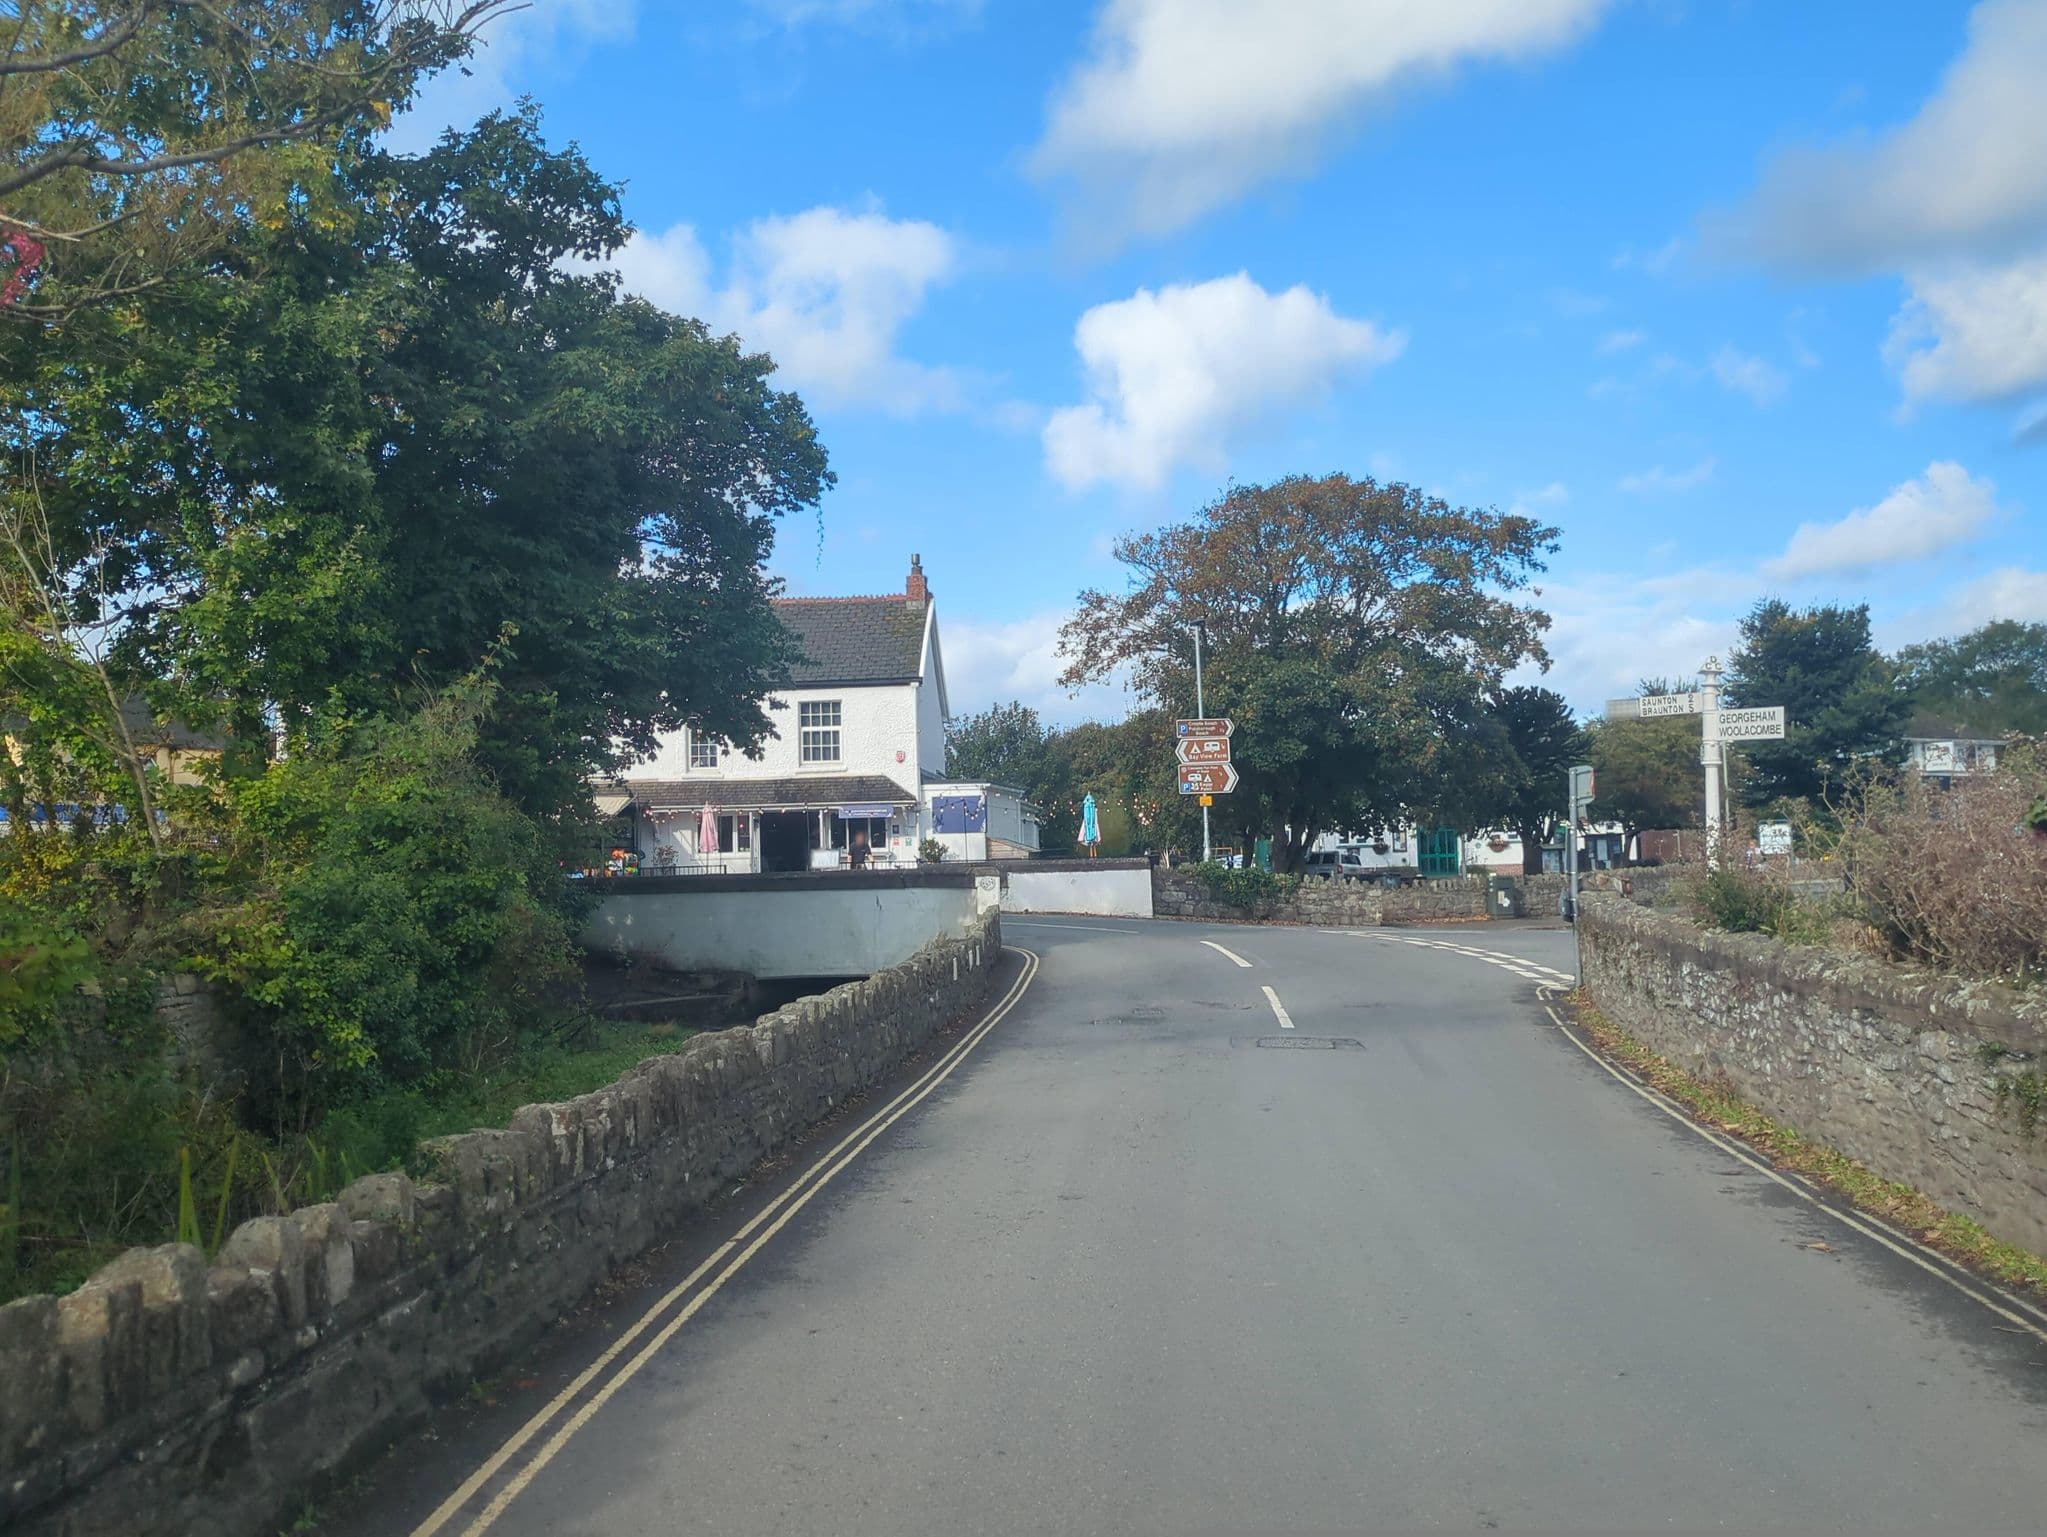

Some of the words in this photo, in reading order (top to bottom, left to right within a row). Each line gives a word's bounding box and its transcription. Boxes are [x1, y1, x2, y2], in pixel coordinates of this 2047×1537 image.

[1710, 655, 1717, 663] D
[1642, 696, 1677, 706] SAUNTON
[1687, 693, 1694, 702] 2
[1642, 704, 1684, 716] BRAUNTON
[1688, 703, 1695, 713] 5
[1719, 710, 1776, 724] GEORGEHAM
[1718, 724, 1782, 737] WOOLACOMBE
